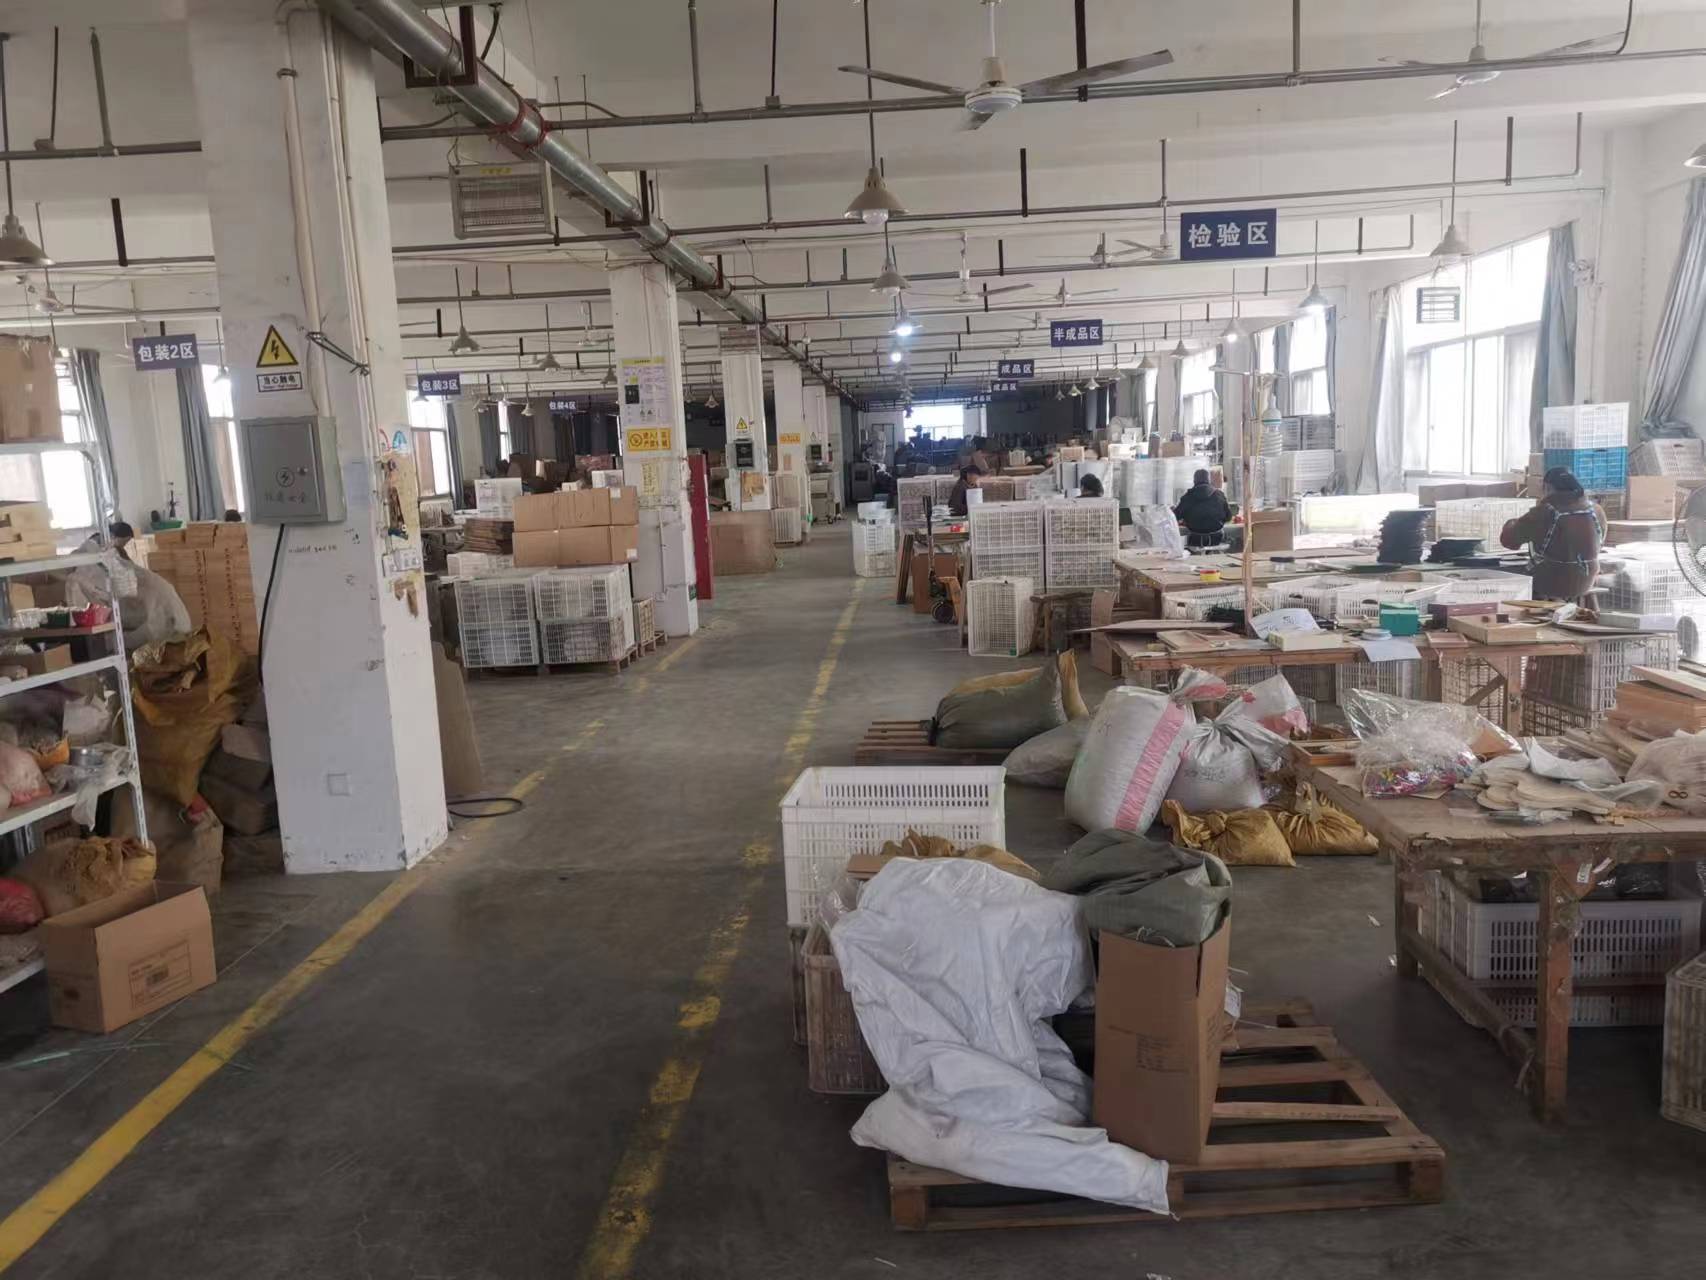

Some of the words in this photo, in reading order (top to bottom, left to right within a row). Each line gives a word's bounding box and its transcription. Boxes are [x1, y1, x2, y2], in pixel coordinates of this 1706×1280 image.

[1188, 222, 1269, 249] 检验区
[1053, 326, 1100, 341] 半成品区
[138, 342, 196, 362] 包装2区
[422, 378, 459, 391] 包装3区
